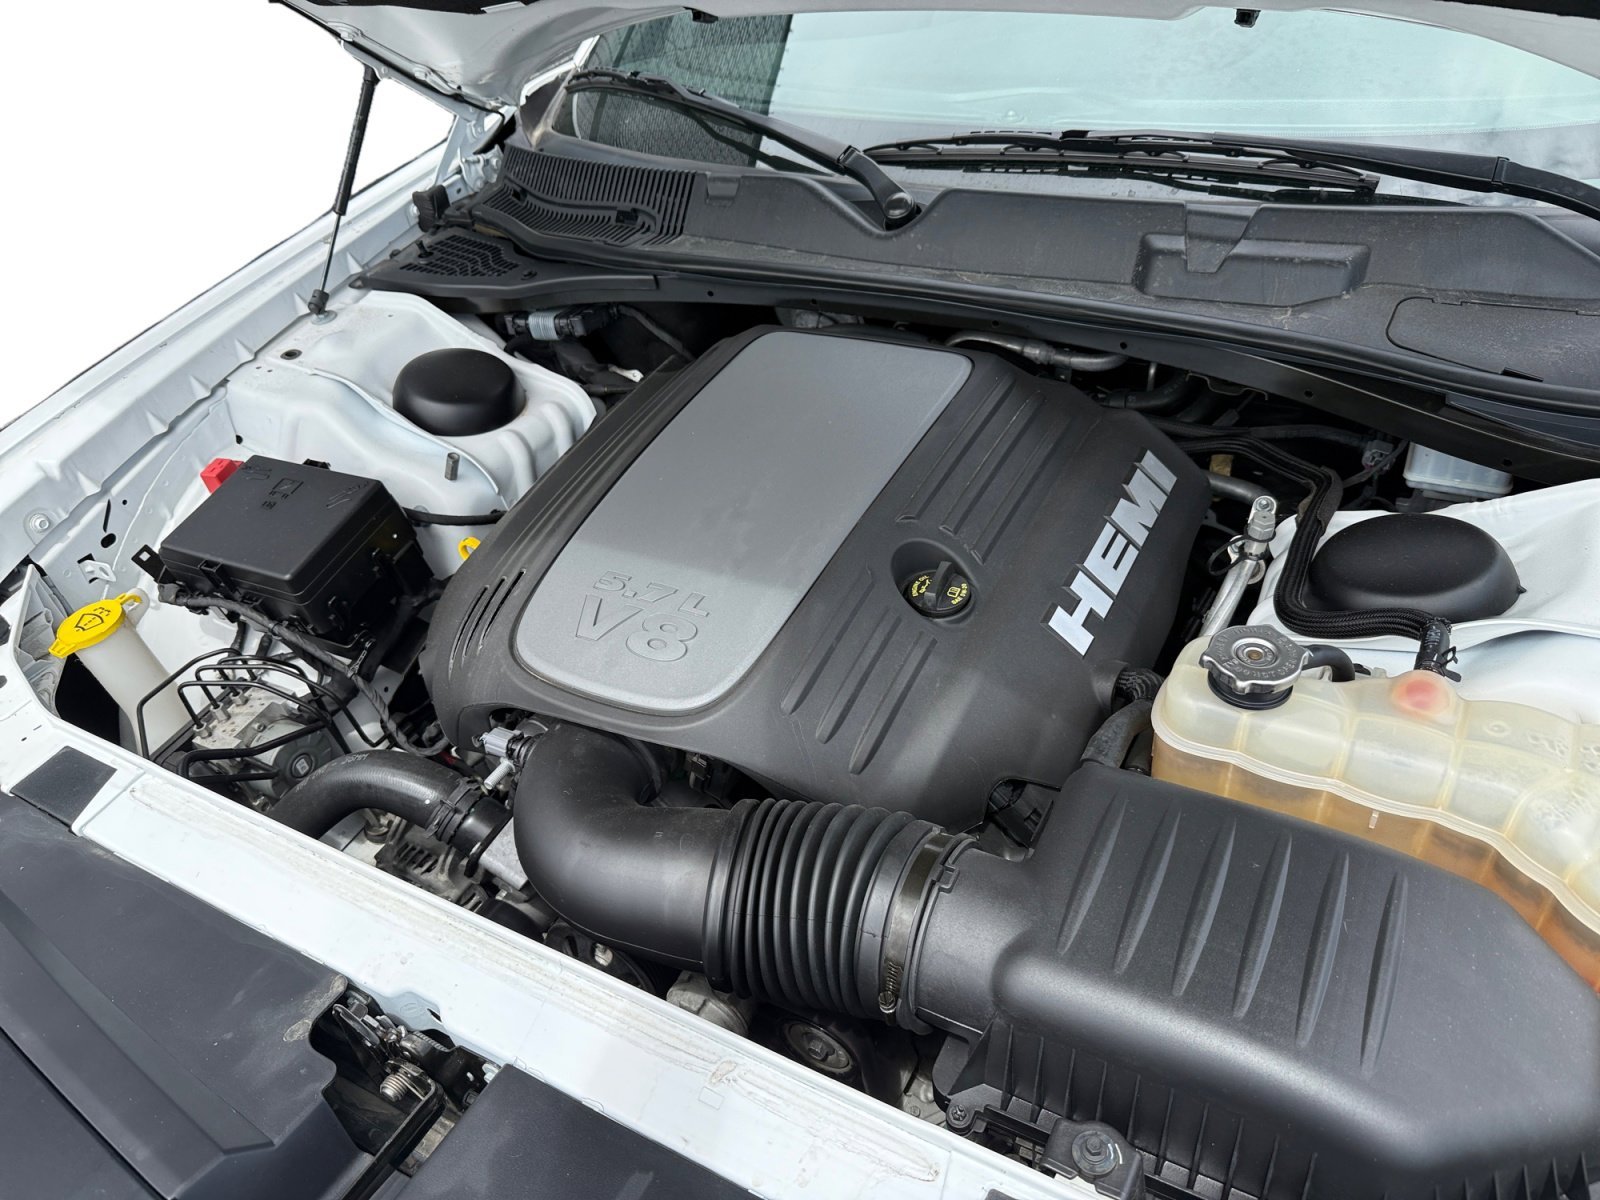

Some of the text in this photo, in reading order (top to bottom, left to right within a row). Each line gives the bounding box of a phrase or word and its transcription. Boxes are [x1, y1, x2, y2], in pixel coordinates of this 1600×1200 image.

[1046, 449, 1177, 657] HEMI
[593, 570, 710, 617] 5.7L
[575, 594, 698, 662] V8
